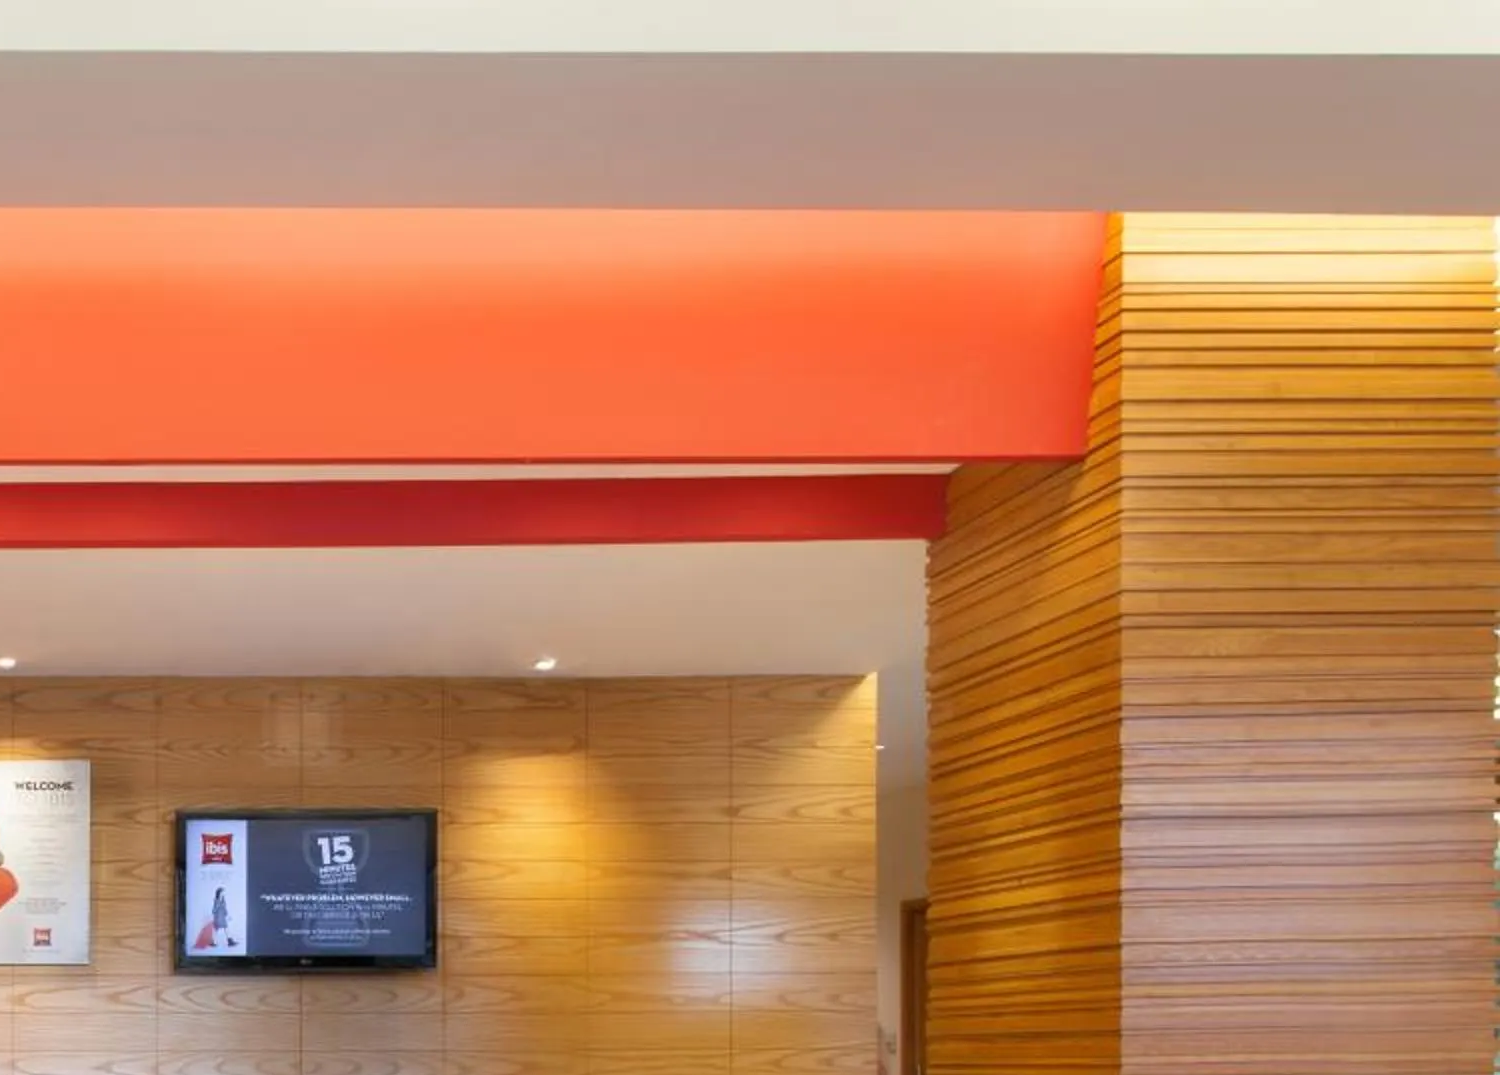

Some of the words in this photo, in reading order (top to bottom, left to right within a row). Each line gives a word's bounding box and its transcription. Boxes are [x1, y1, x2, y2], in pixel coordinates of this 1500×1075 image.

[14, 781, 75, 791] WELCOME
[205, 841, 229, 855] ibis
[317, 836, 354, 864] 15
